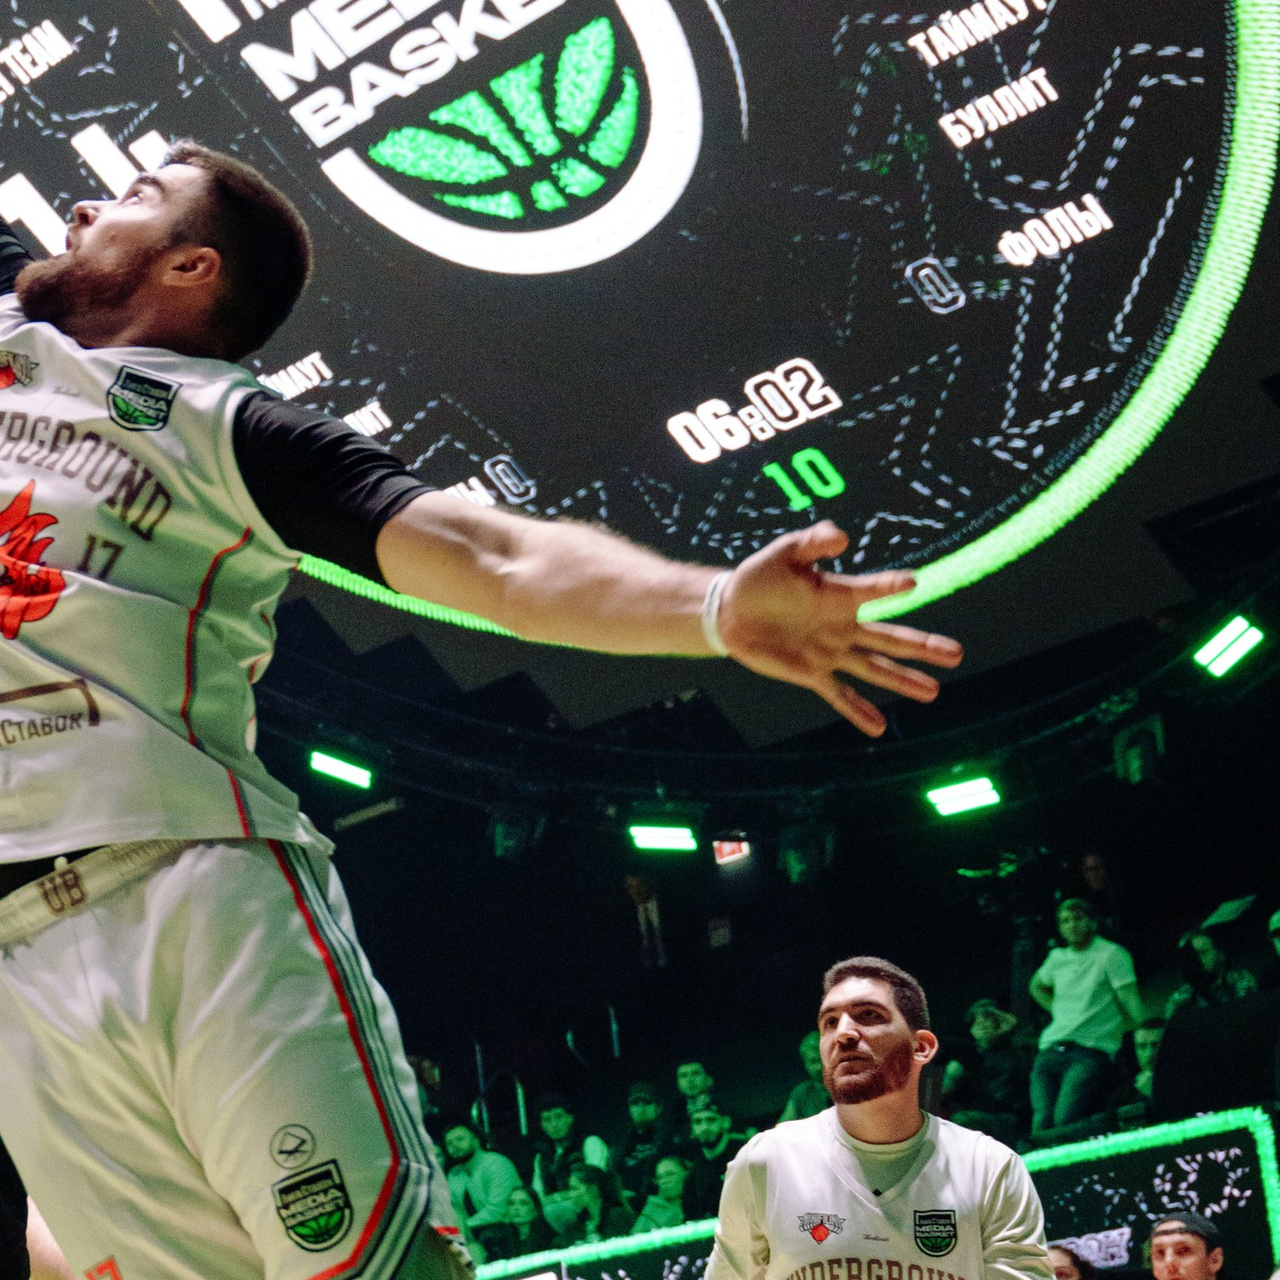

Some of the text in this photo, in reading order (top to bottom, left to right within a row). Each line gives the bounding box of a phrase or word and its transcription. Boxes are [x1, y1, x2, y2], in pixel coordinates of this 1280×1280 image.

[937, 68, 1059, 148] БУЛЛИТ
[996, 192, 1114, 267] ФОЛЫ
[667, 357, 842, 463] 06:02
[762, 447, 845, 511] 10
[77, 533, 124, 580] 17
[0, 711, 84, 745] СТАВОК
[35, 867, 86, 916] UB
